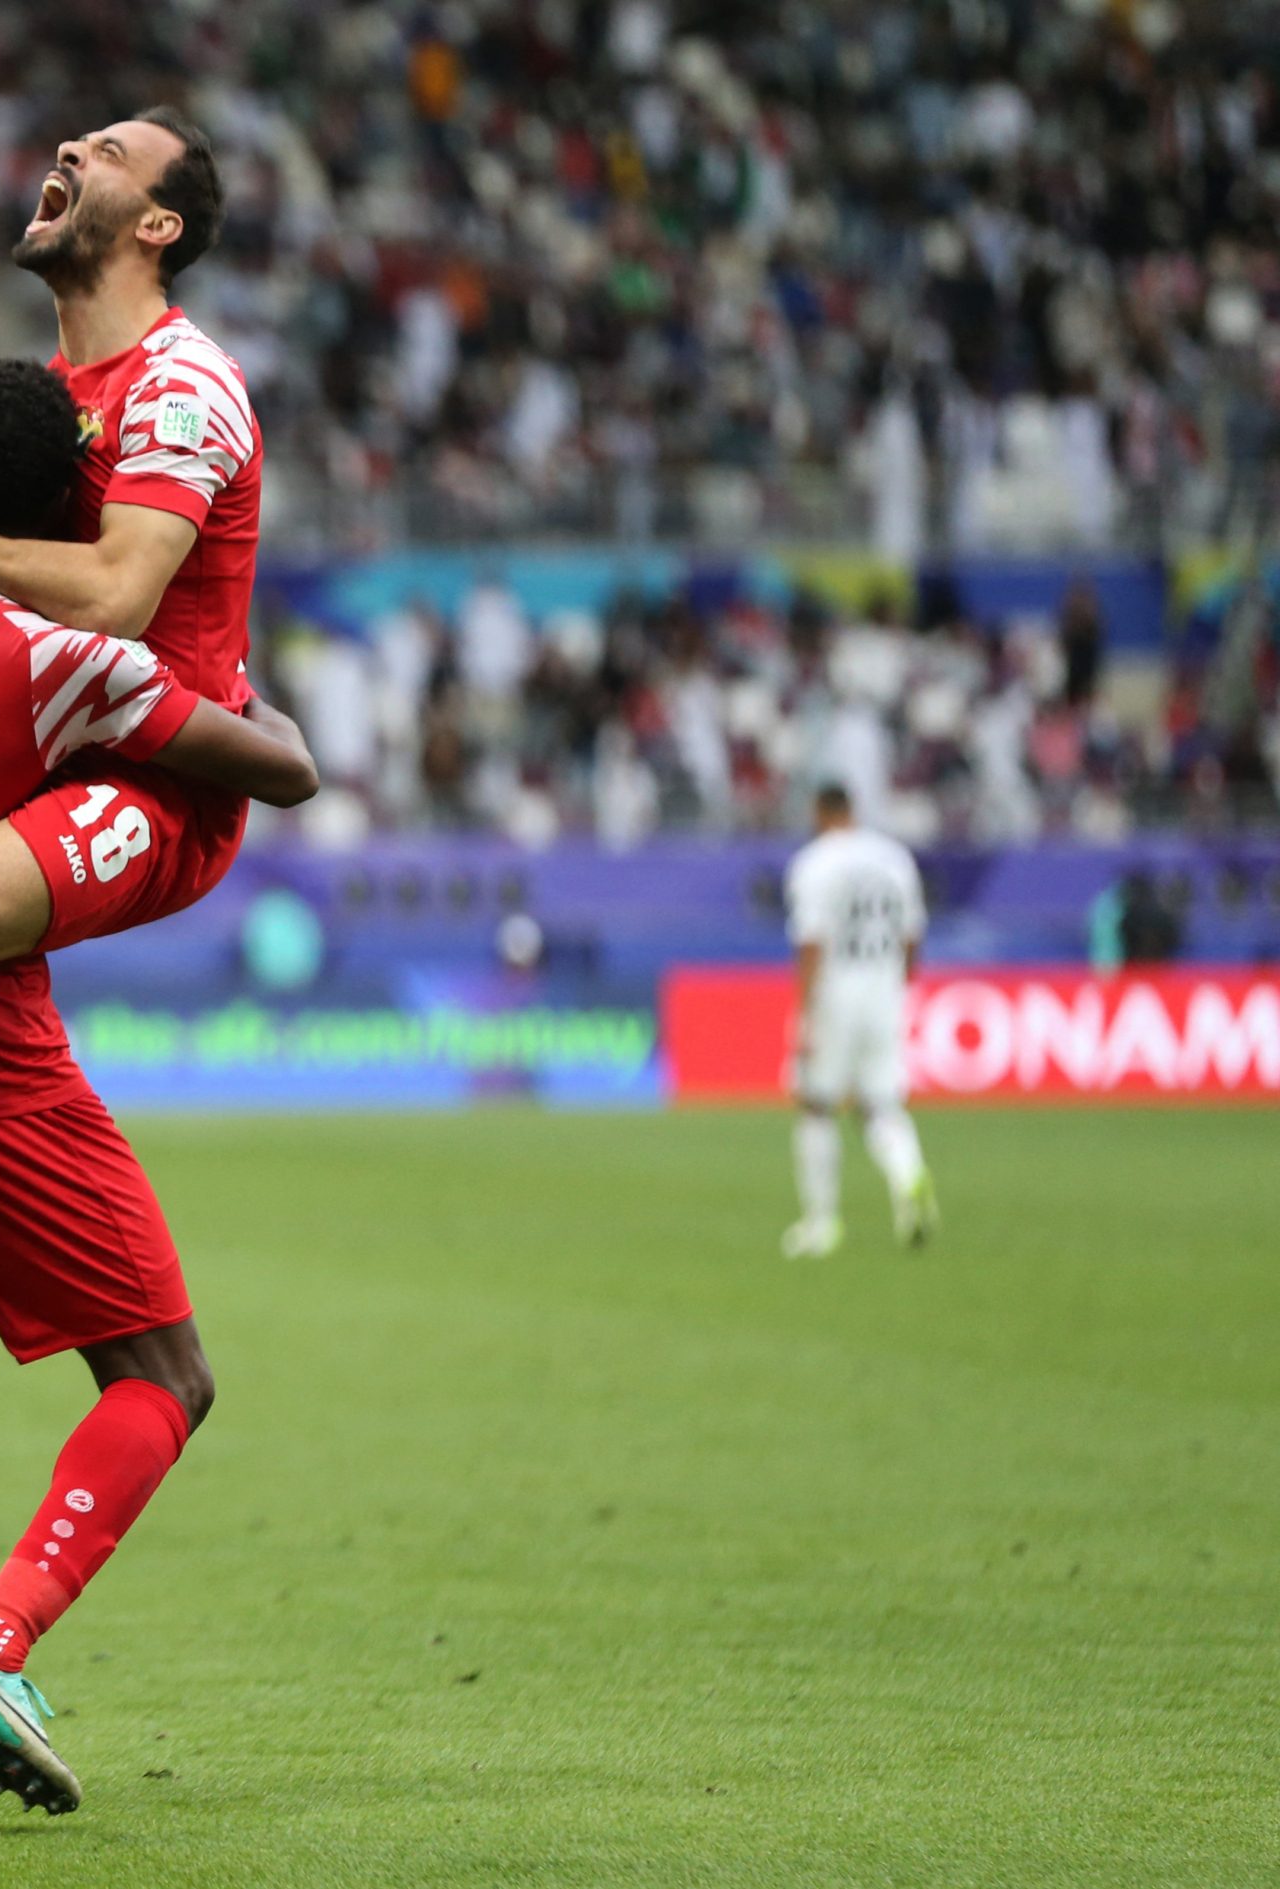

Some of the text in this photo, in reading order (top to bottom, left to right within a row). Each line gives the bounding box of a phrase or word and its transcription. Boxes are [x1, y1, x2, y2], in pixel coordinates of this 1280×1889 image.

[164, 409, 200, 427] LIVE
[166, 401, 189, 411] AFC
[68, 783, 151, 882] 18
[58, 834, 87, 884] JAKO
